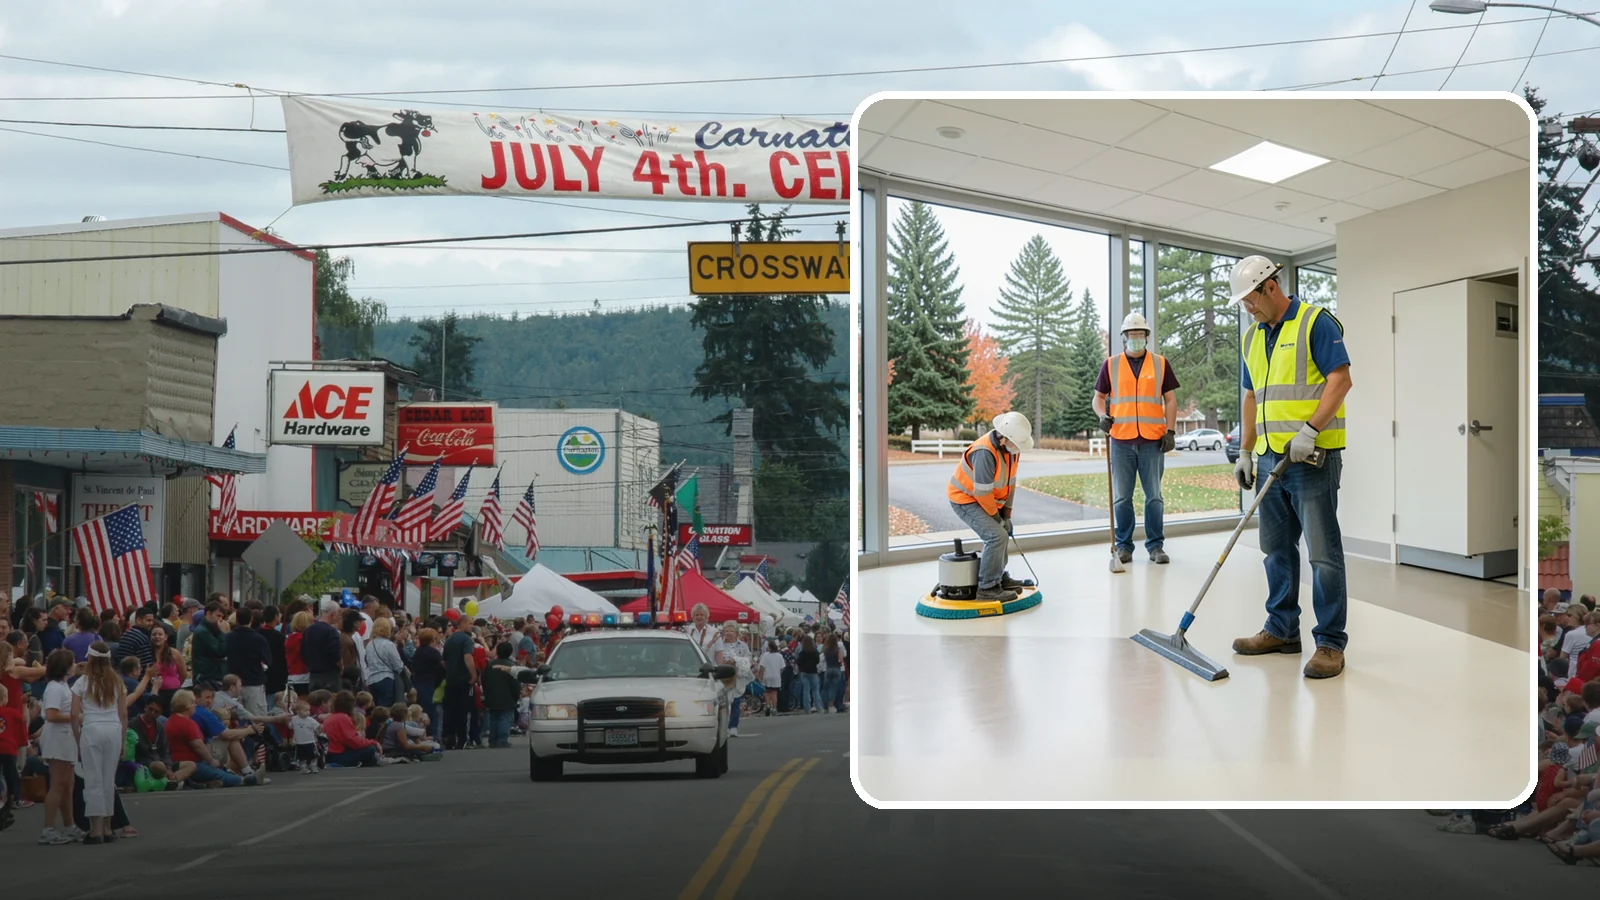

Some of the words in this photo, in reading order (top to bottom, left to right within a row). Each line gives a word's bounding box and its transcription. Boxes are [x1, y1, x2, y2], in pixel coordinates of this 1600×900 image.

[481, 141, 605, 193] JULY
[633, 150, 746, 197] 4th.
[697, 254, 850, 280] CROSSWA
[283, 380, 373, 419] ACE
[406, 409, 452, 421] CEDAR
[283, 421, 371, 436] Hardware
[416, 428, 477, 447] Coca-Cola
[353, 467, 386, 480] Simpl
[83, 485, 93, 493] St.
[96, 485, 124, 494] Vincent
[126, 486, 135, 495] de
[137, 486, 155, 495] Paul
[81, 503, 154, 522] THT
[688, 526, 741, 535] CRNATION
[699, 535, 730, 543] GLASS
